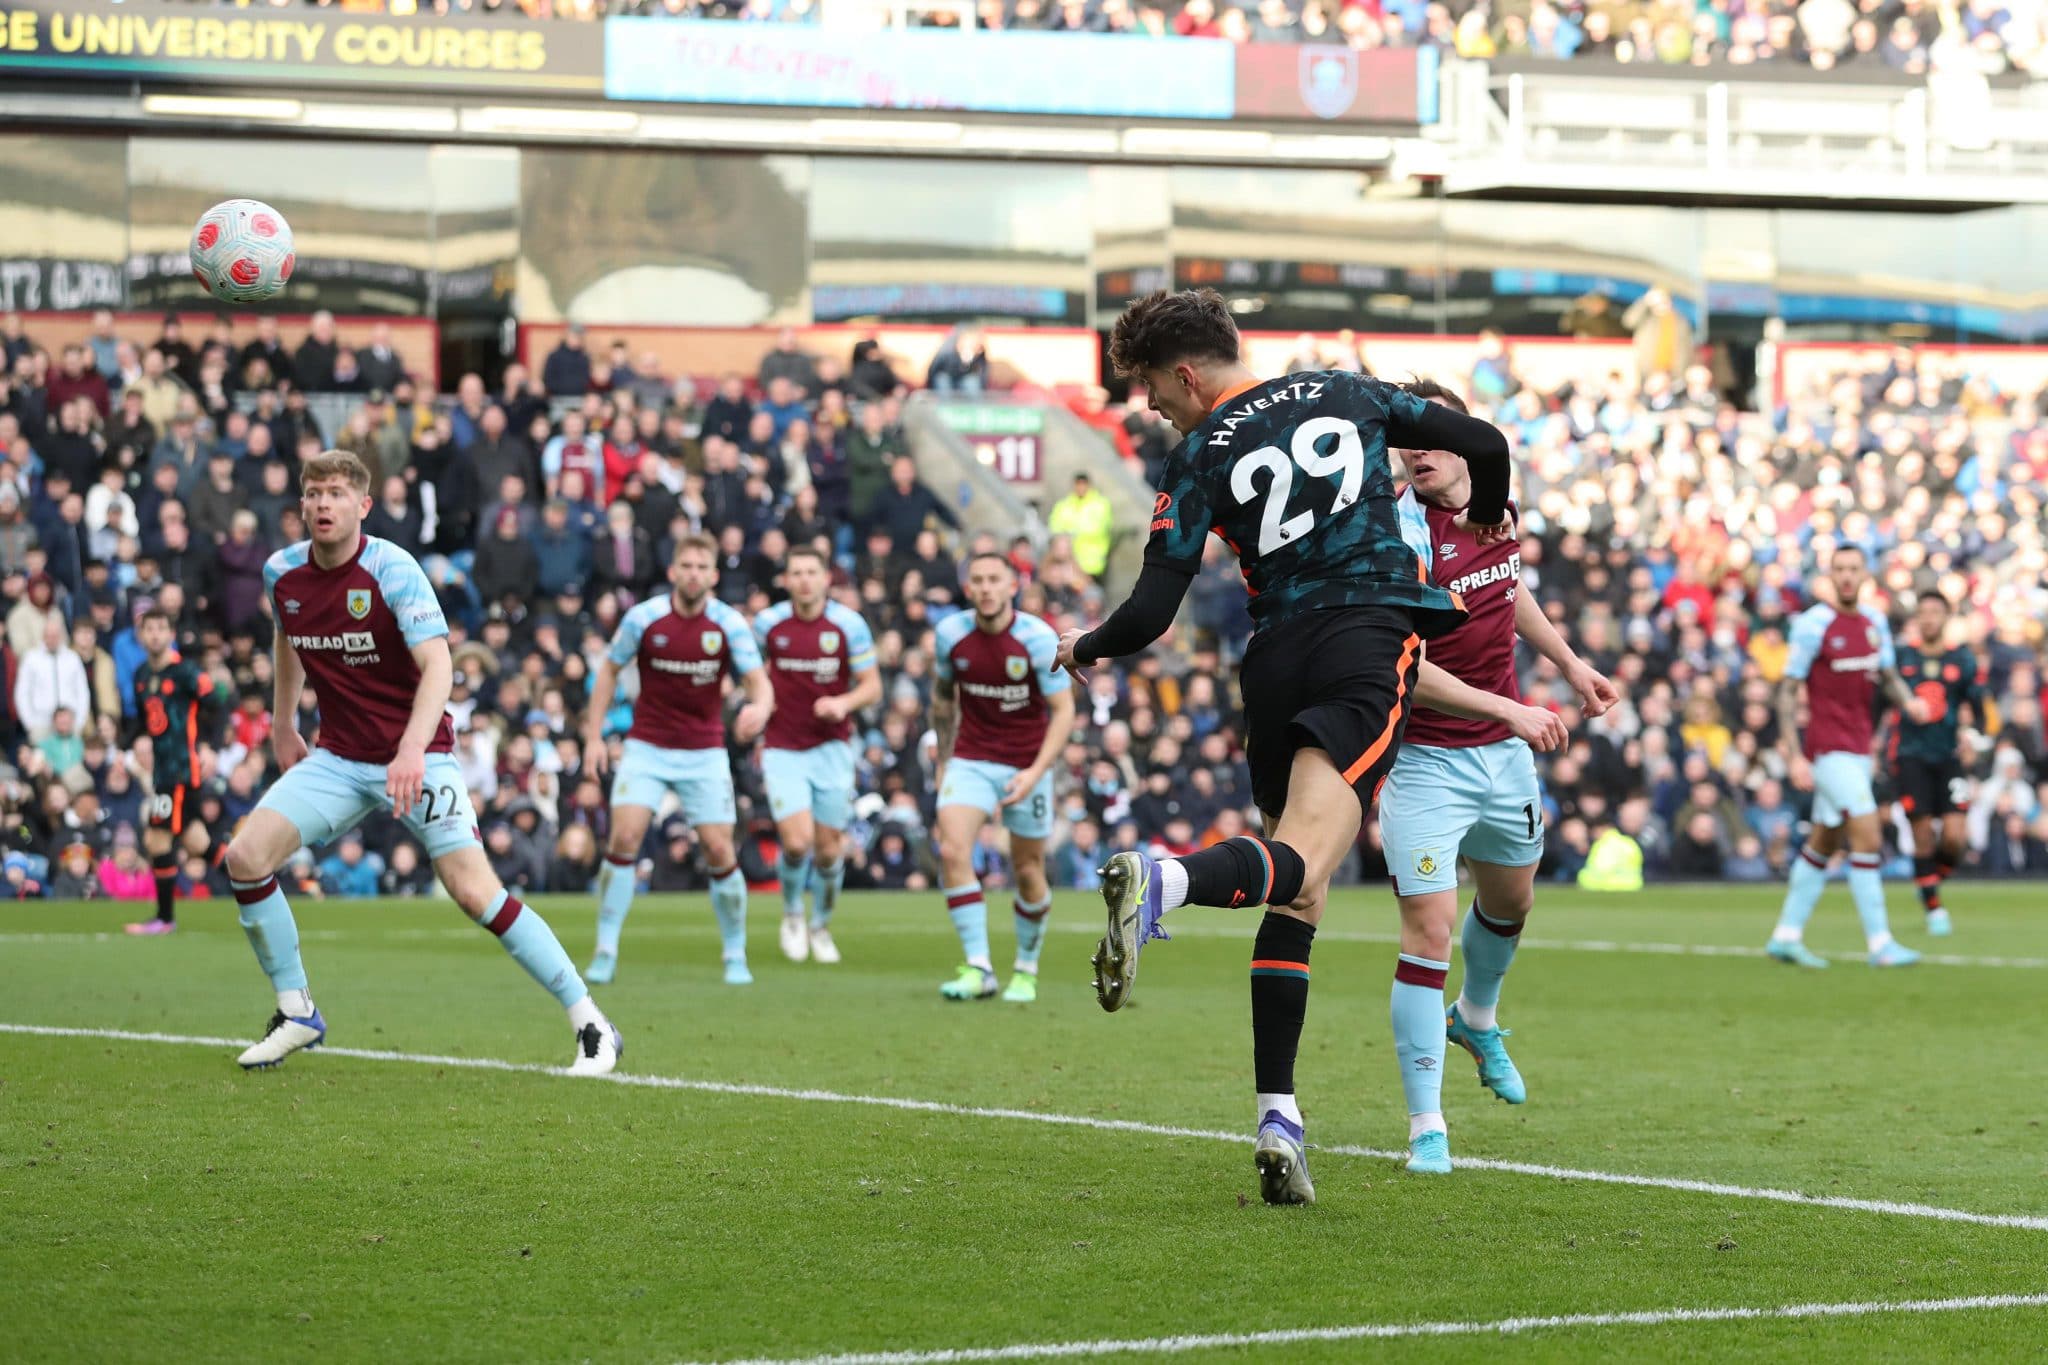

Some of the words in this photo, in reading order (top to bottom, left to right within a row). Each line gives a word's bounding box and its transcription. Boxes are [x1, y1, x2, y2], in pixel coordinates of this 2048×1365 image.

[0, 11, 38, 51] E
[51, 13, 325, 63] UNIVERSITY
[334, 24, 546, 71] COURSES
[1208, 382, 1324, 446] HAVERTZ
[997, 437, 1035, 480] 11
[1230, 416, 1364, 558] 29
[342, 653, 381, 667] Sports
[420, 785, 462, 824] 22
[1032, 795, 1047, 819] 8
[1523, 803, 1542, 840] 1
